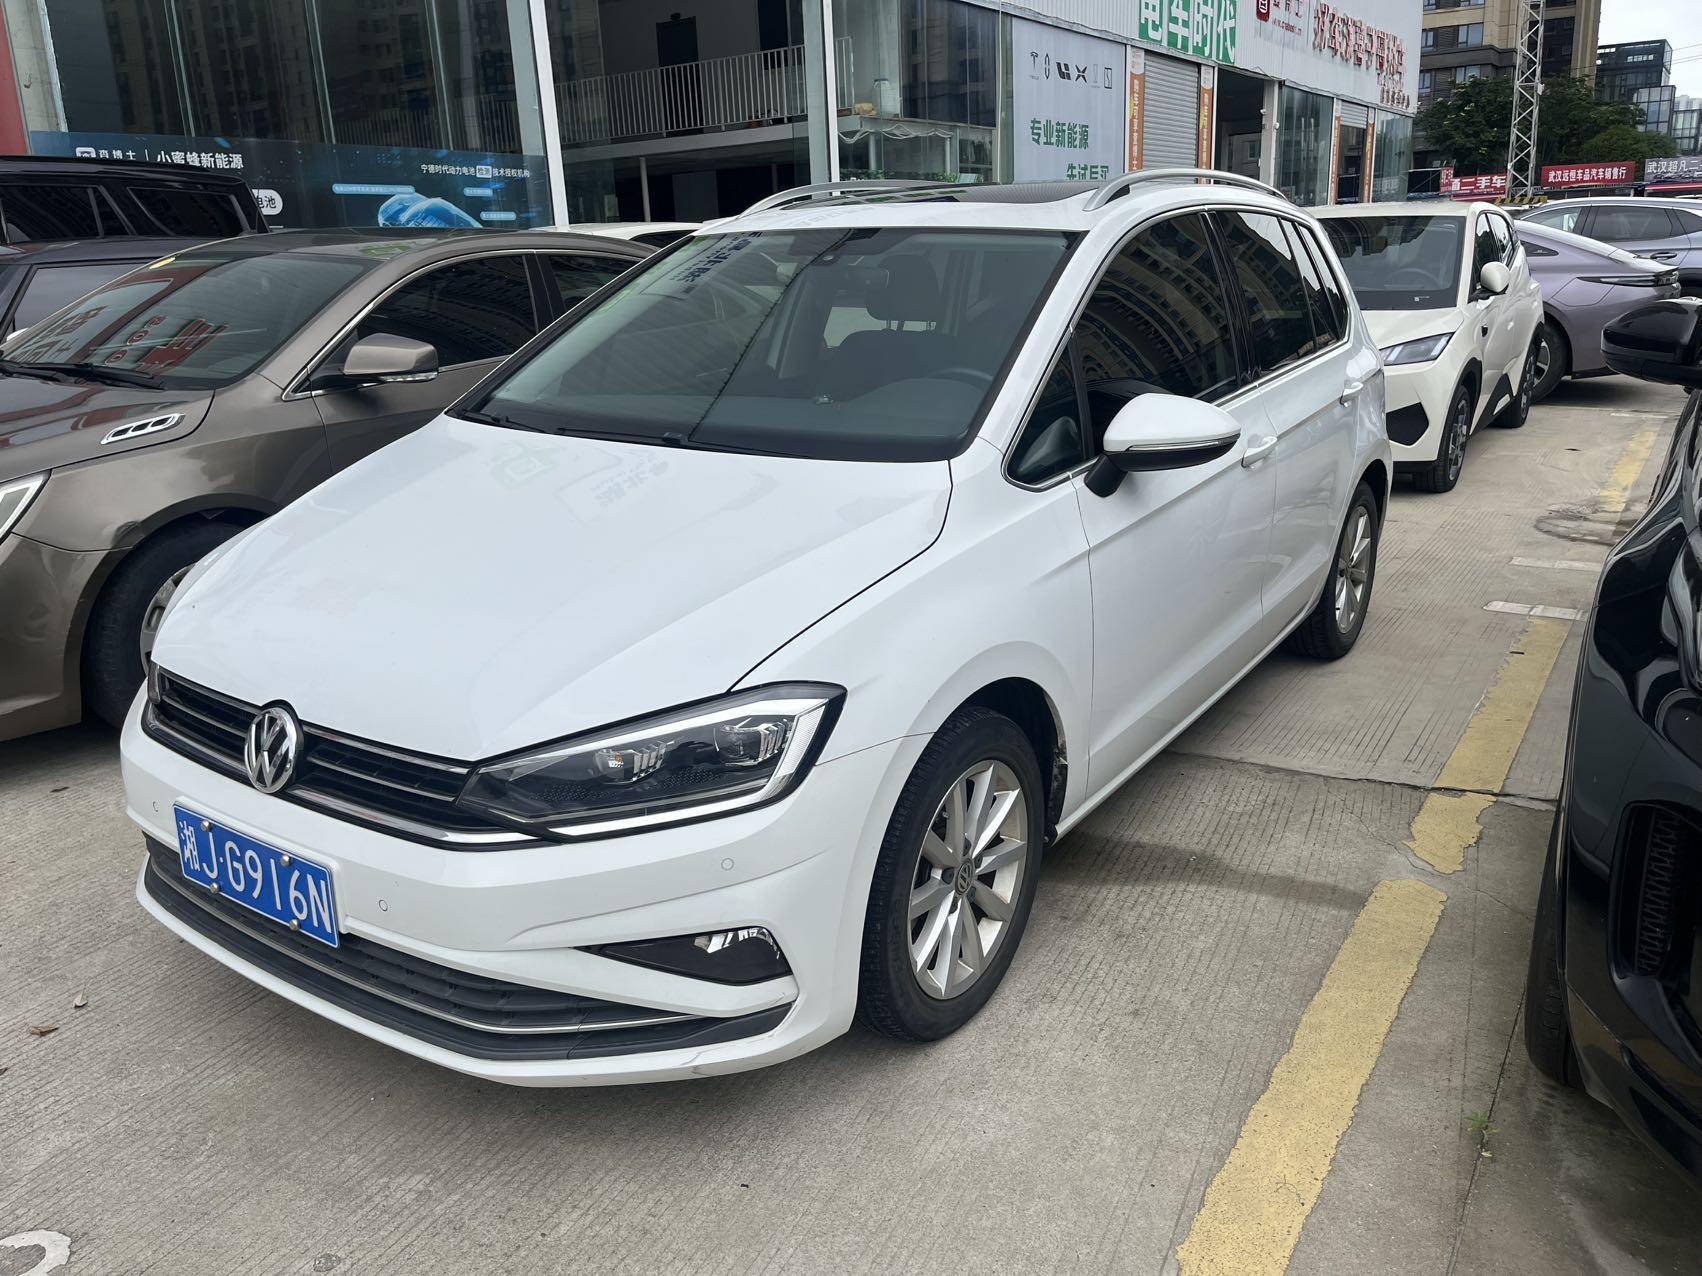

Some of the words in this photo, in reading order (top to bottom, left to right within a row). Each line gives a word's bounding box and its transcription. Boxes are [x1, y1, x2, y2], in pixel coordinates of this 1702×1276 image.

[1030, 117, 1089, 149] 专业新能源
[156, 150, 244, 170] 小蜜蜂新能源
[1647, 159, 1702, 174] 武汉超凡二
